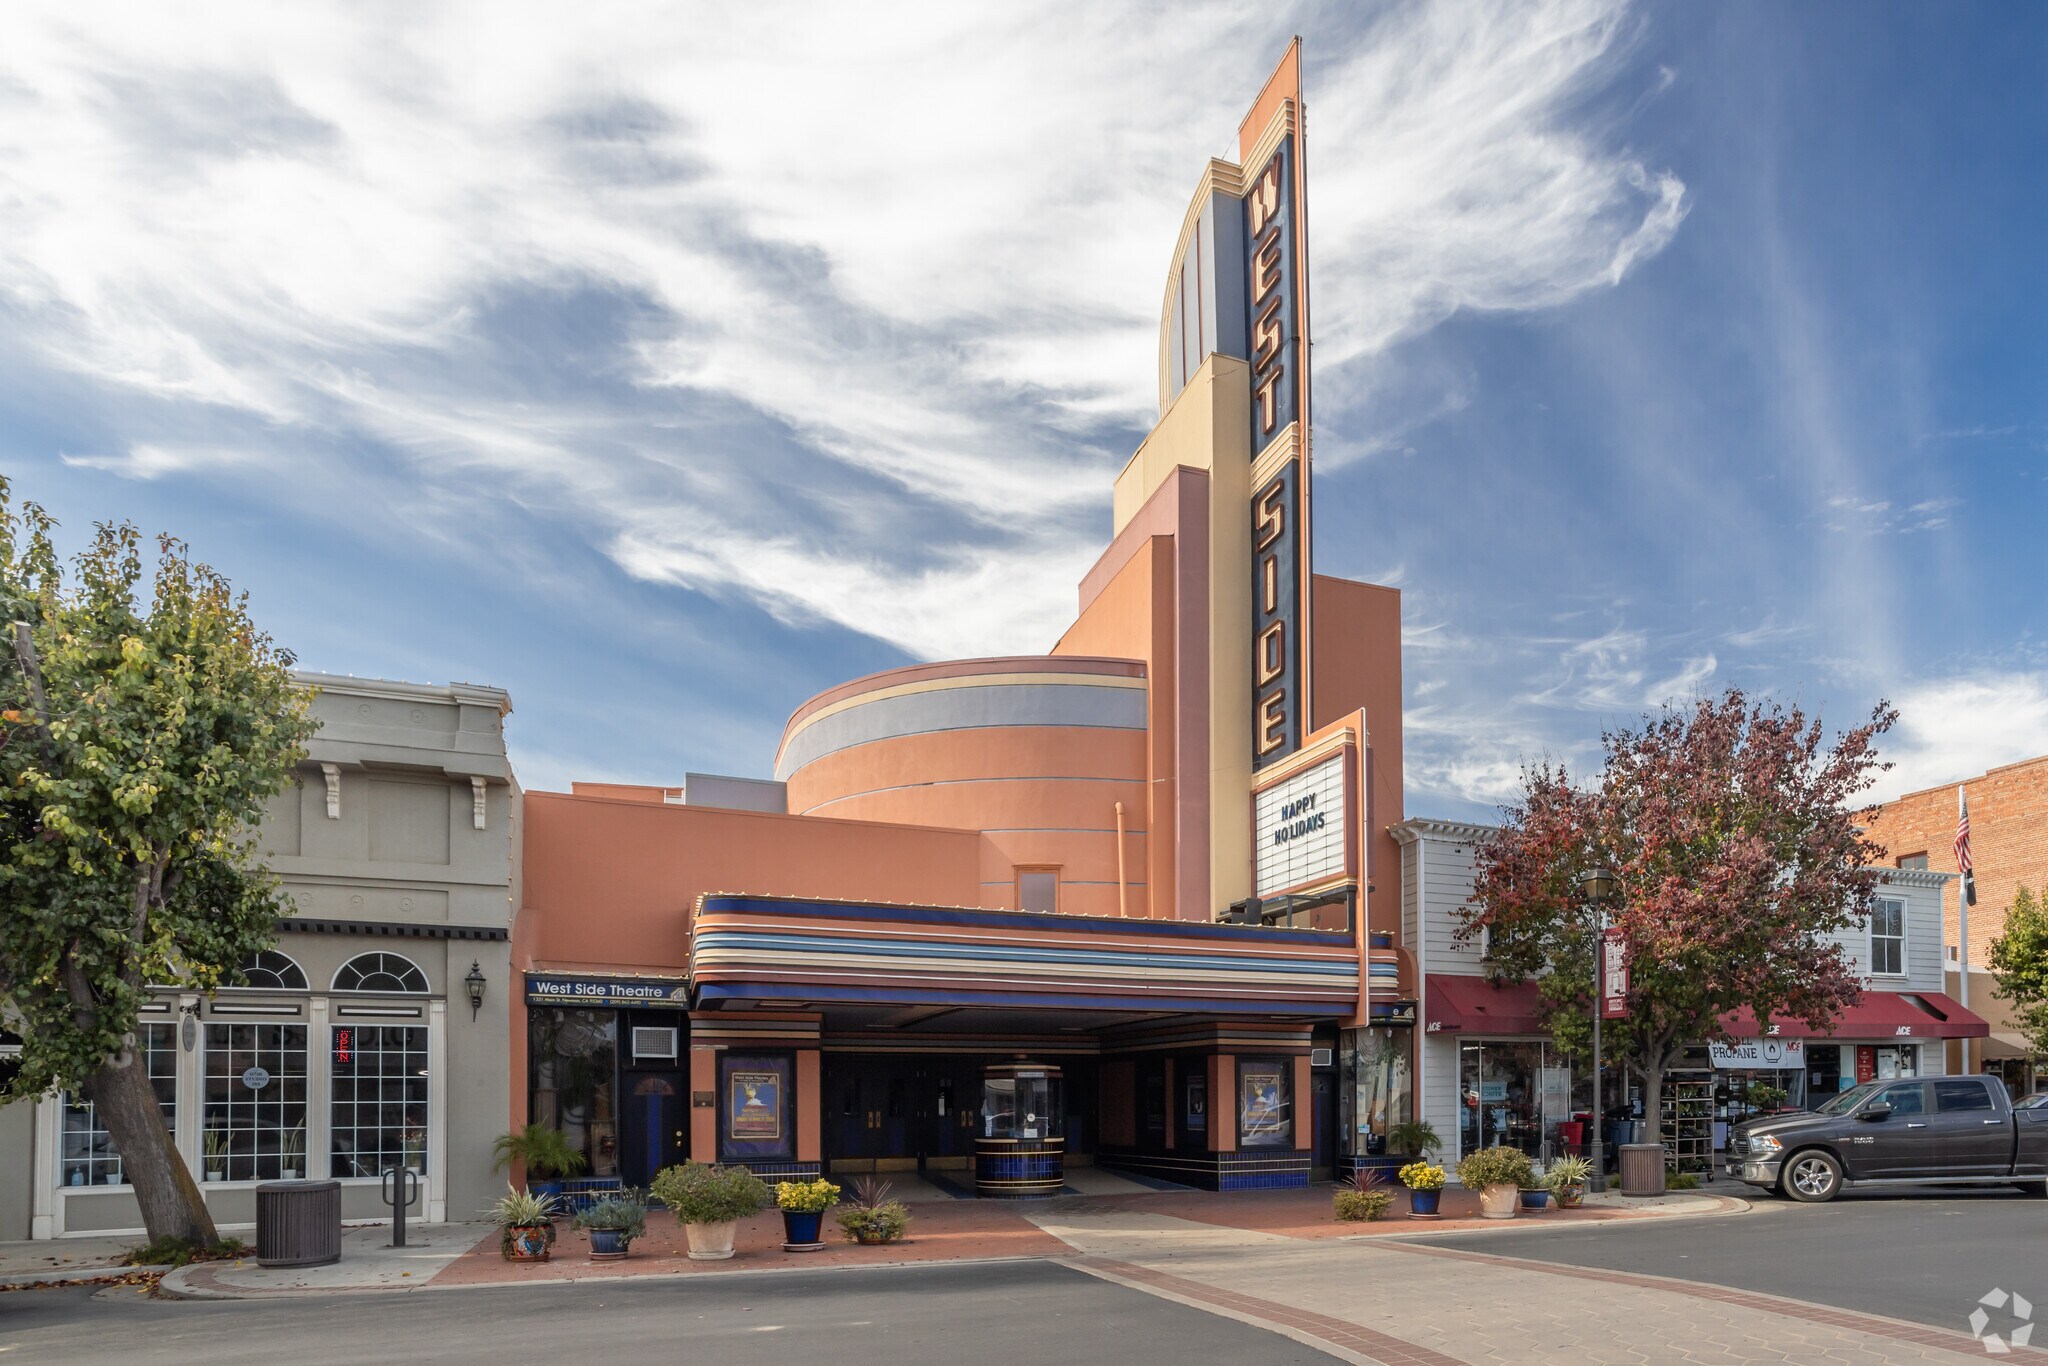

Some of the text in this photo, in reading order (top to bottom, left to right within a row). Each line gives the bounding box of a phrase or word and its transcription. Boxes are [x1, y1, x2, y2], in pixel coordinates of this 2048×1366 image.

[1248, 151, 1283, 436] WEST
[1255, 478, 1286, 756] SIDE
[1282, 792, 1316, 822] HAPPY
[1275, 811, 1325, 846] HOLIDAYS
[536, 982, 663, 998] West Side Theatre
[1427, 1021, 1441, 1032] ACE
[1896, 1026, 1911, 1036] ACE
[340, 1032, 349, 1061] OPEN
[1712, 1047, 1757, 1059] PROPANE
[1786, 1041, 1800, 1052] ACE
